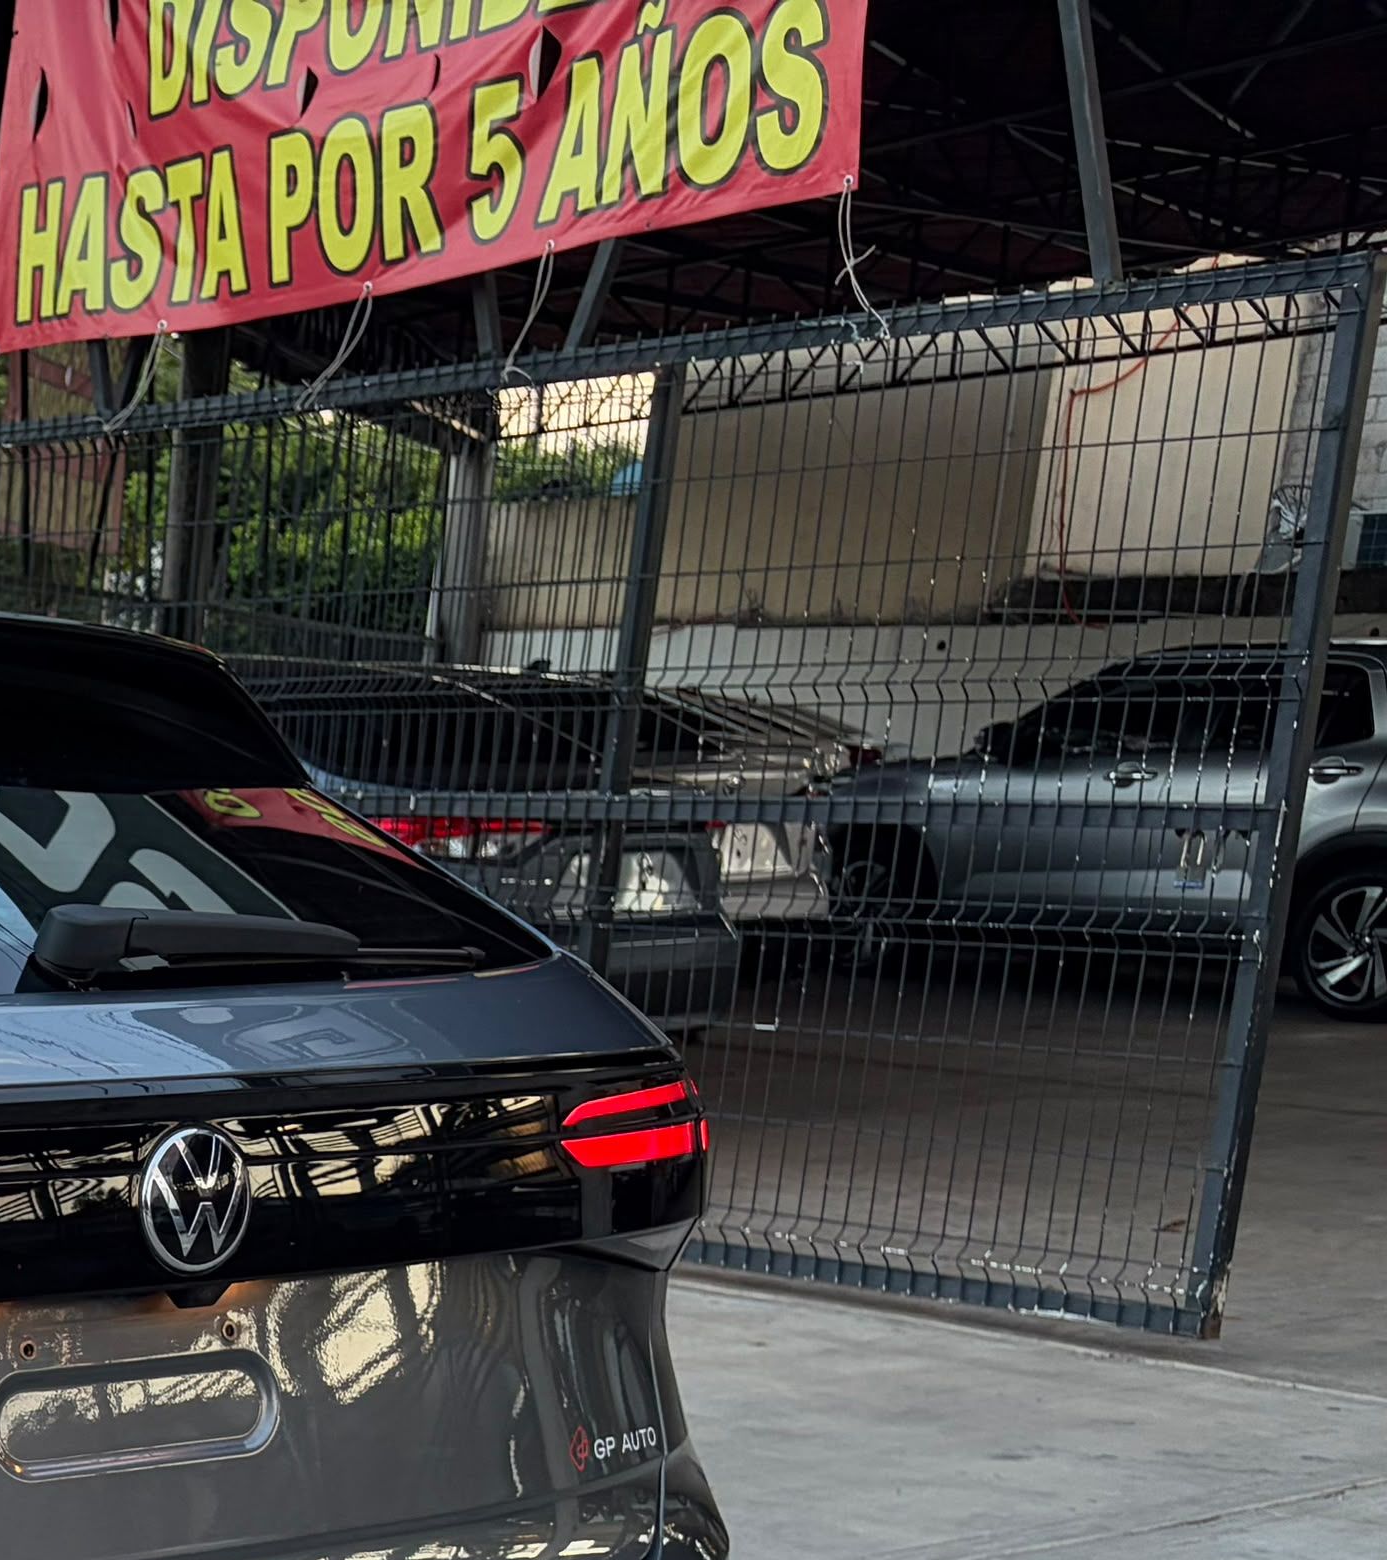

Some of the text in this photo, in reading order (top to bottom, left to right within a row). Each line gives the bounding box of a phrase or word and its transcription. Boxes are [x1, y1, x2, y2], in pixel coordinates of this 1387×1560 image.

[14, 0, 829, 327] HASTA POR 5 AÑOS
[593, 1426, 657, 1460] GP AUTO
